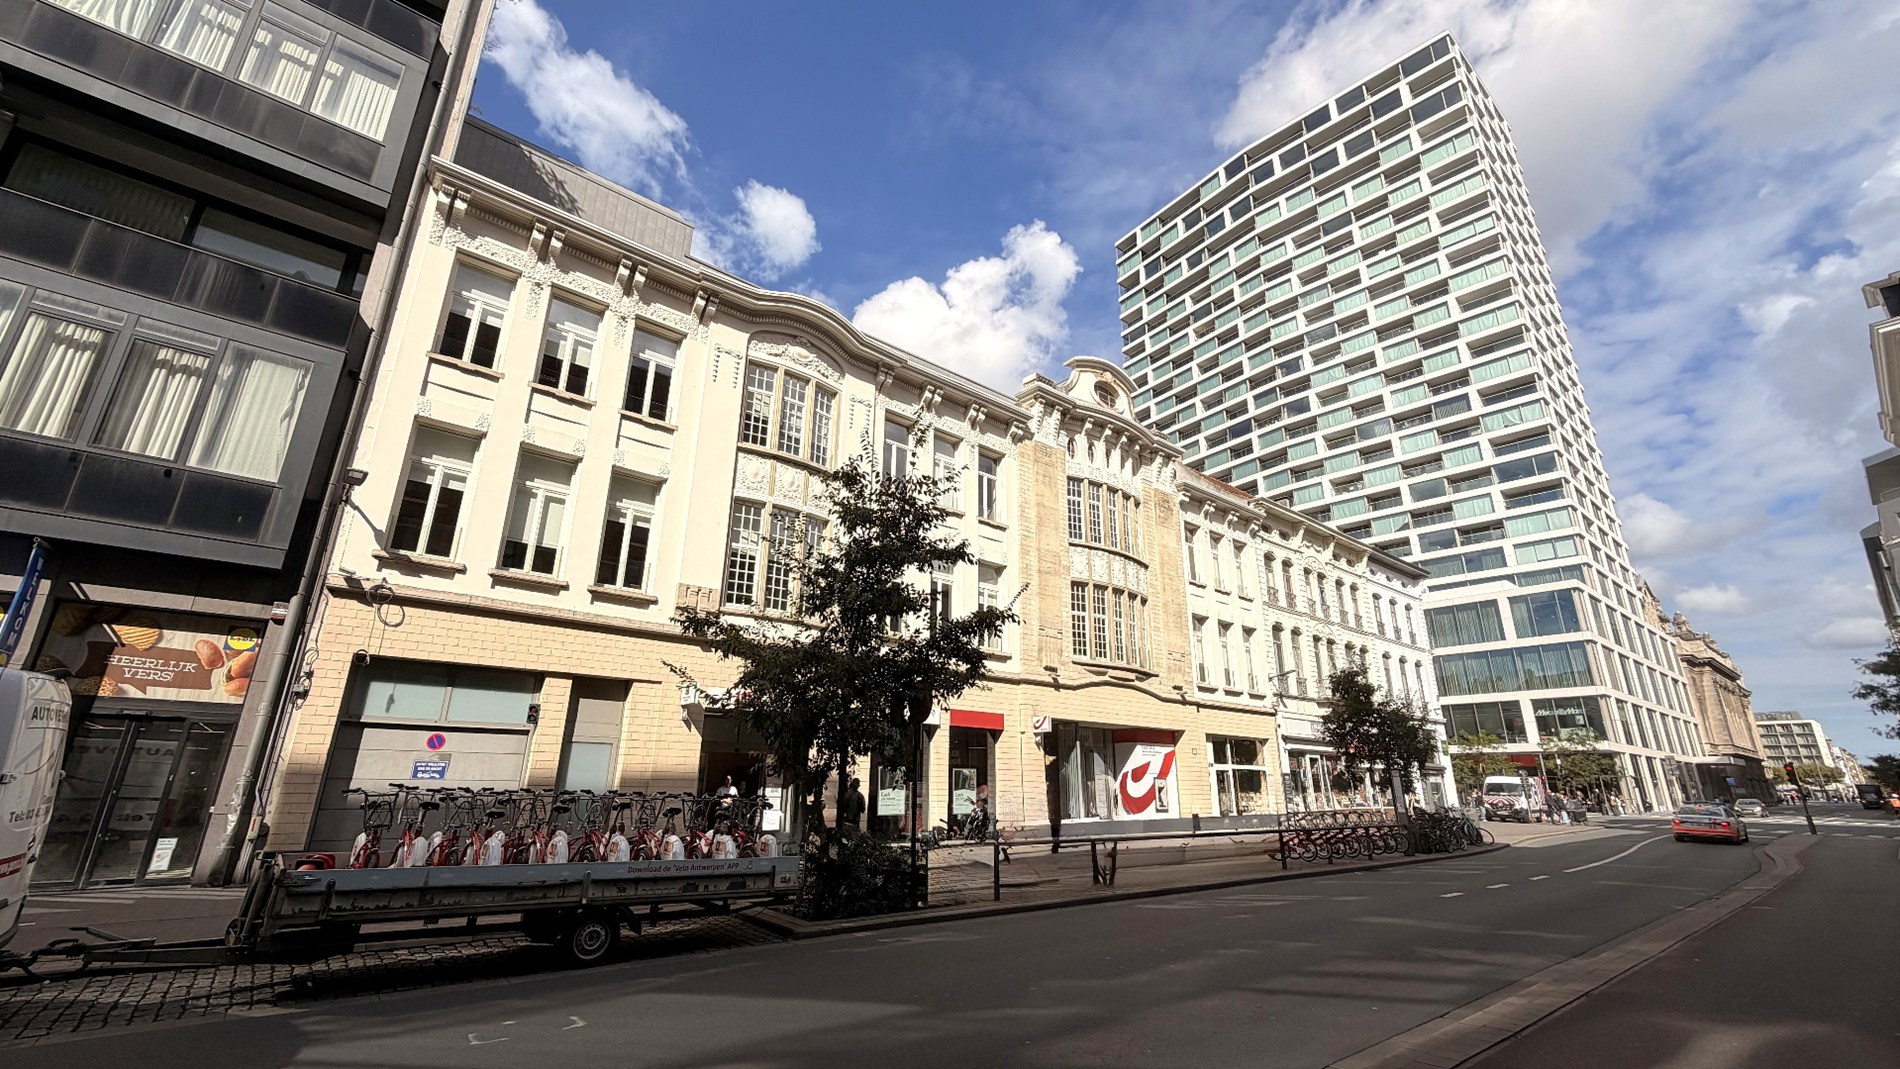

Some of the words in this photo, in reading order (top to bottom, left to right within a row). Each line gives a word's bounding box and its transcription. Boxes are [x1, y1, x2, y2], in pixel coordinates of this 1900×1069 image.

[104, 655, 198, 673] HEERLIJK
[122, 667, 175, 682] VERS!
[627, 864, 662, 874] Download
[663, 865, 672, 873] de
